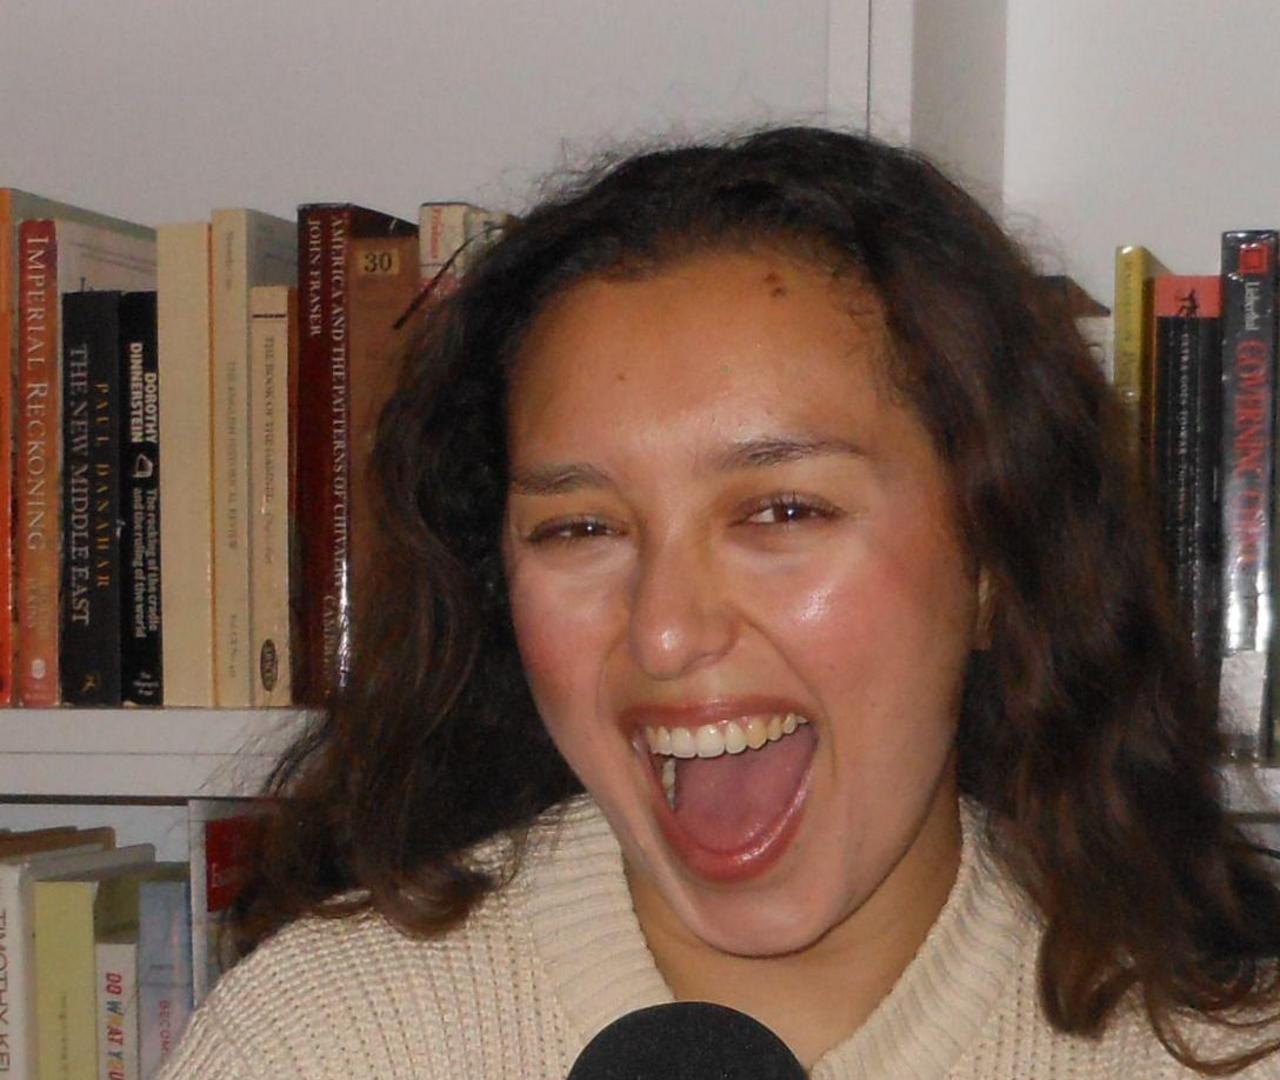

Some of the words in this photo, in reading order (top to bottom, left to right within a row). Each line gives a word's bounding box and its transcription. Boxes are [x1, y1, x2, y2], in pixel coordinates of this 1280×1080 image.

[308, 220, 321, 265] JOHN
[331, 216, 345, 298] AMERICA
[365, 253, 392, 272] 30
[26, 237, 48, 370] IMPERIAL
[309, 270, 321, 337] FRASER
[332, 305, 345, 341] AND
[71, 343, 87, 396] THE
[332, 347, 345, 378] THE
[130, 343, 143, 443] DINNERSTEIN
[143, 373, 156, 443] DOROTHY
[71, 402, 88, 455] NEW
[332, 385, 346, 471] PATTERNS
[26, 382, 48, 551] RECKONING
[133, 488, 145, 510] and
[146, 488, 158, 509] The
[333, 477, 346, 498] OF
[71, 464, 88, 559] MIDDLE
[133, 512, 145, 532] the
[132, 533, 145, 567] ruling
[145, 511, 158, 557] rocking
[134, 569, 145, 581] of
[147, 559, 158, 571] of
[147, 574, 158, 593] the
[71, 568, 88, 624] EAST
[134, 583, 145, 602] the
[135, 604, 146, 638] world
[148, 595, 158, 632] cradle
